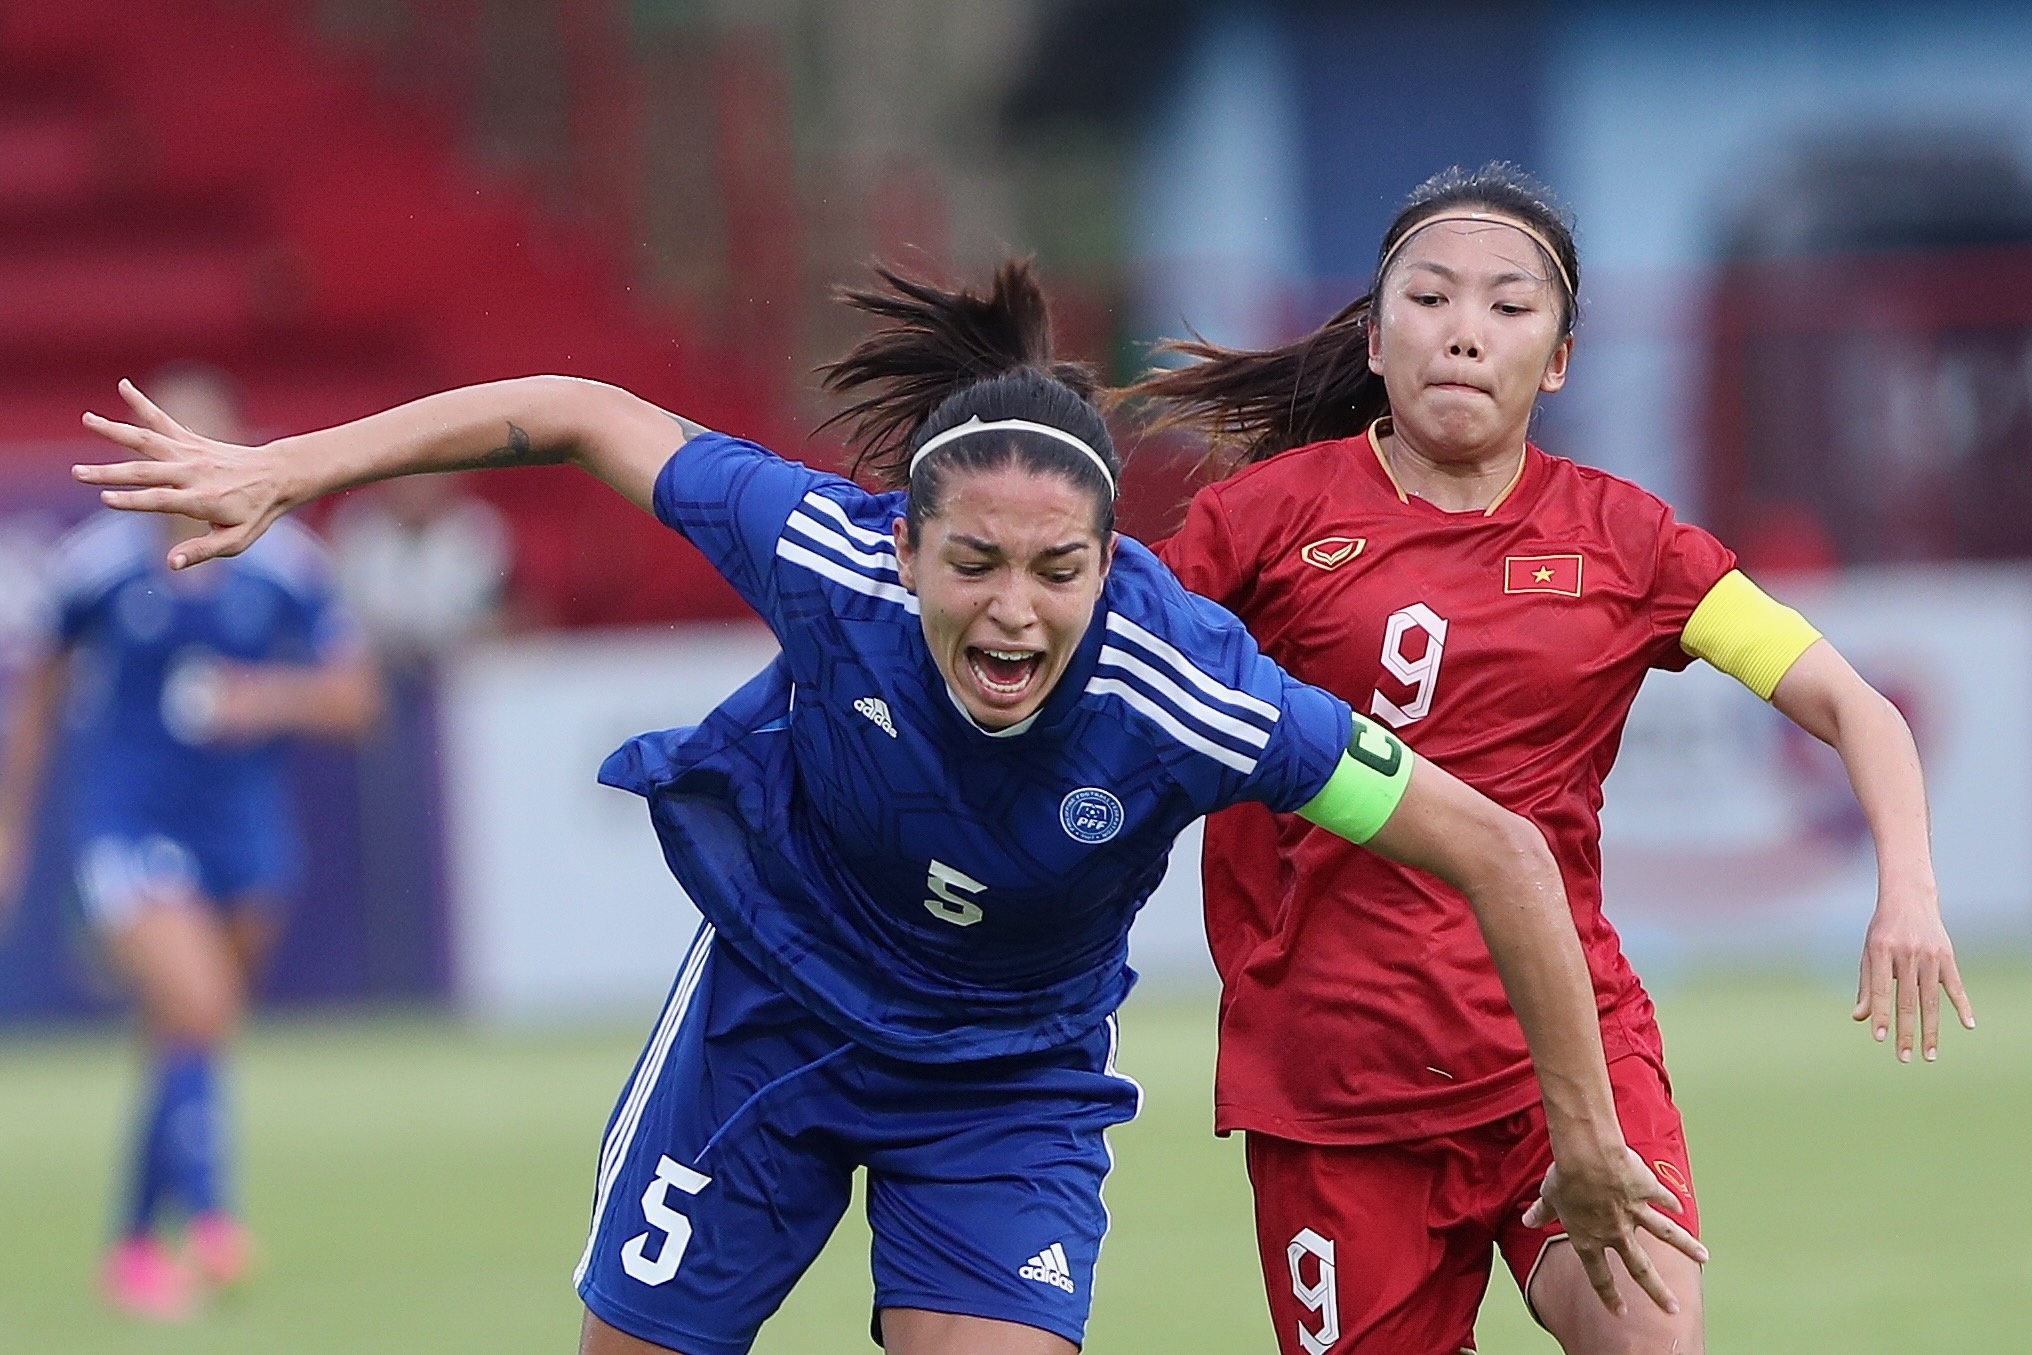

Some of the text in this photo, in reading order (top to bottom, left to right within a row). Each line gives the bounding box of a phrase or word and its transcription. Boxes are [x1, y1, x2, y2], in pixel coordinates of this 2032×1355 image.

[1370, 602, 1449, 729] 9
[853, 699, 898, 738] adidas
[1346, 719, 1402, 777] C
[1076, 816, 1107, 830] PFF
[923, 858, 988, 927] 5
[620, 1154, 712, 1286] 5
[1018, 1265, 1074, 1294] adidas
[1286, 1227, 1340, 1355] 9
